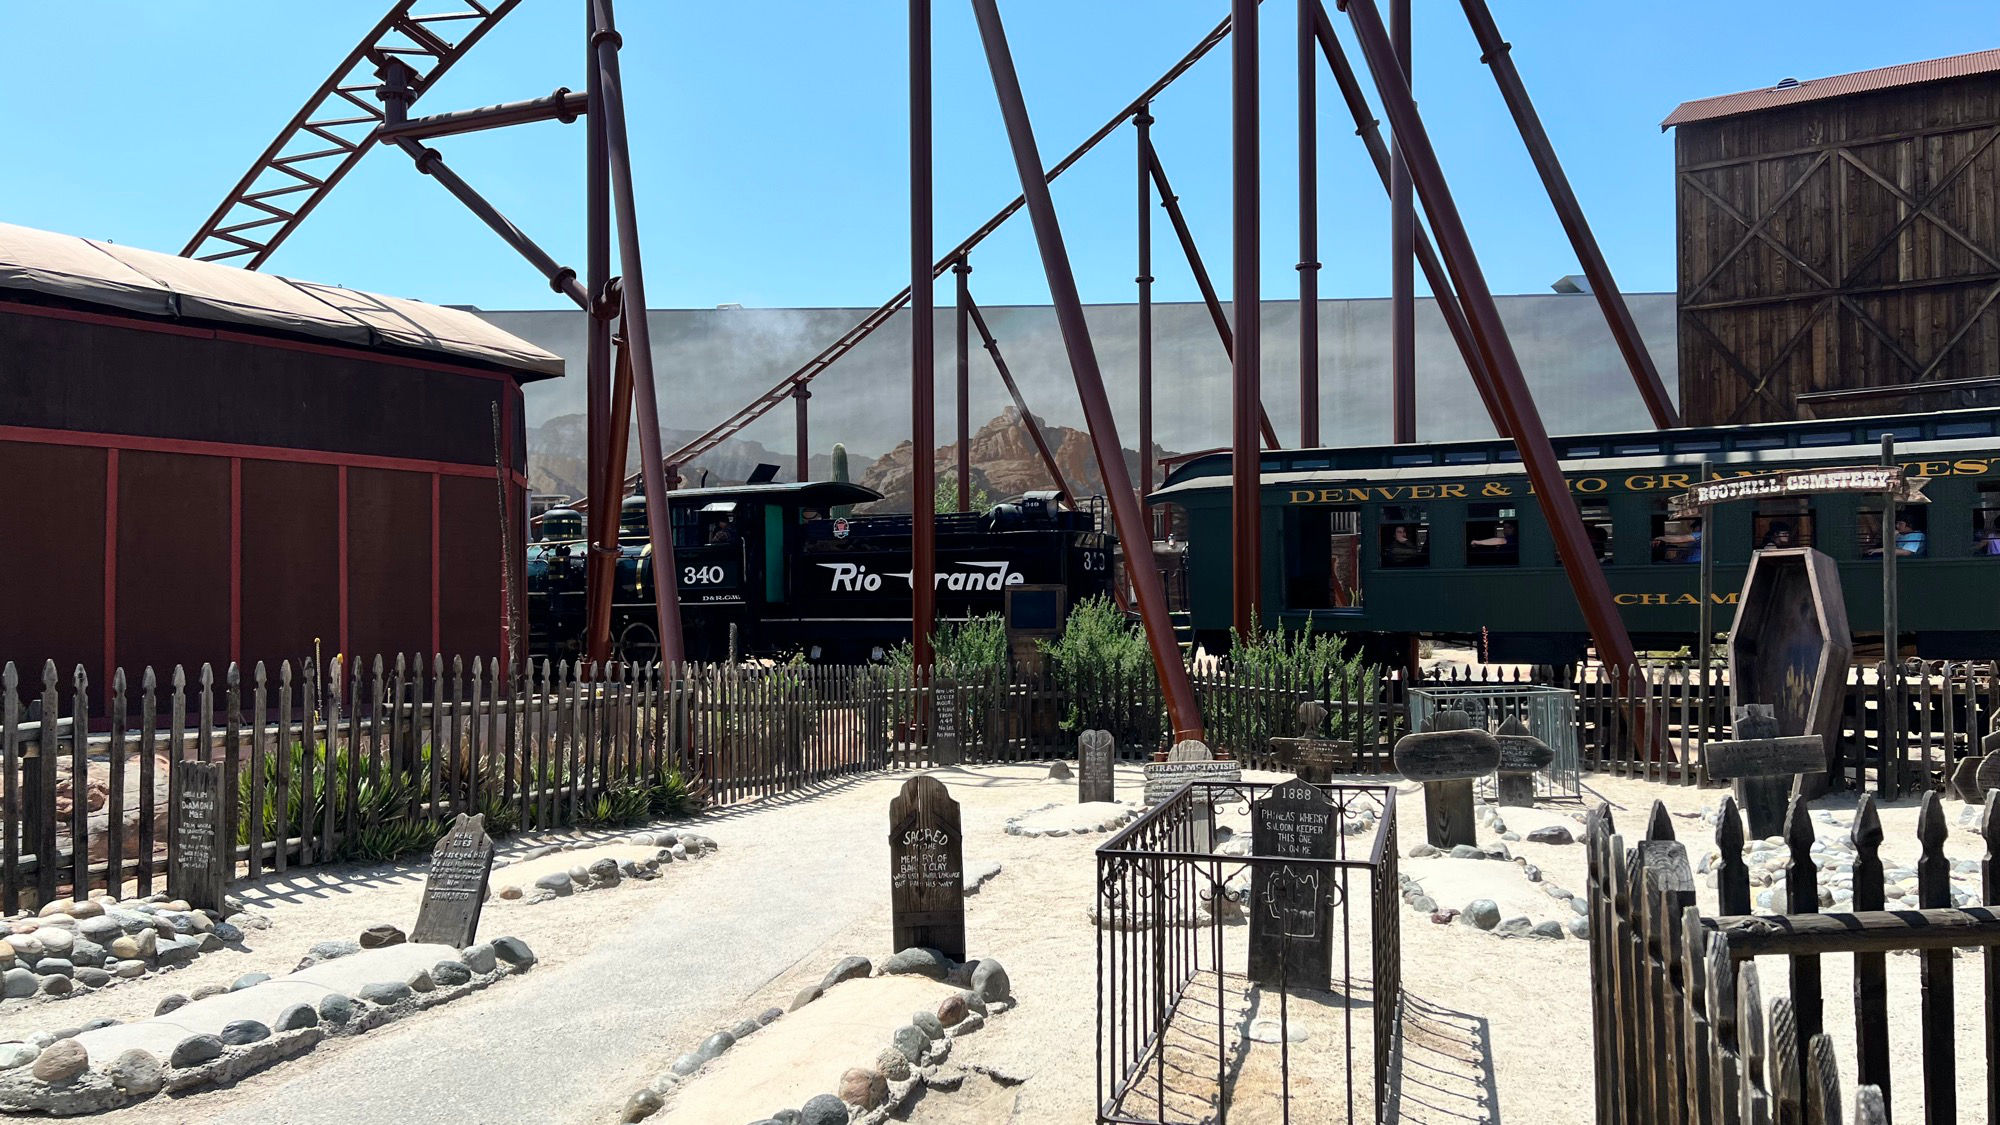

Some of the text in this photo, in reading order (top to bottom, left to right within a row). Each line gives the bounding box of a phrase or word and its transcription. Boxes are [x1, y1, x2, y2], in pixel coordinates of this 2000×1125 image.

[1898, 457, 2000, 477] ES
[1289, 483, 1468, 504] DENVER
[1481, 481, 1512, 496] &
[1527, 477, 1608, 494] IO
[1698, 478, 1780, 502] BOOTHILL
[1786, 471, 1890, 490] CEMETERY
[683, 565, 725, 585] 340
[816, 561, 1025, 592] Rio rande
[1148, 764, 1183, 772] HIRAM
[1282, 787, 1312, 801] 1888
[1261, 809, 1296, 821] PHINEAS
[1266, 822, 1324, 834] SALOON KEEPER
[902, 828, 949, 846] SACRED
[1277, 833, 1312, 844] THIS ONE
[937, 853, 948, 863] OF
[928, 862, 947, 872] CLAY
